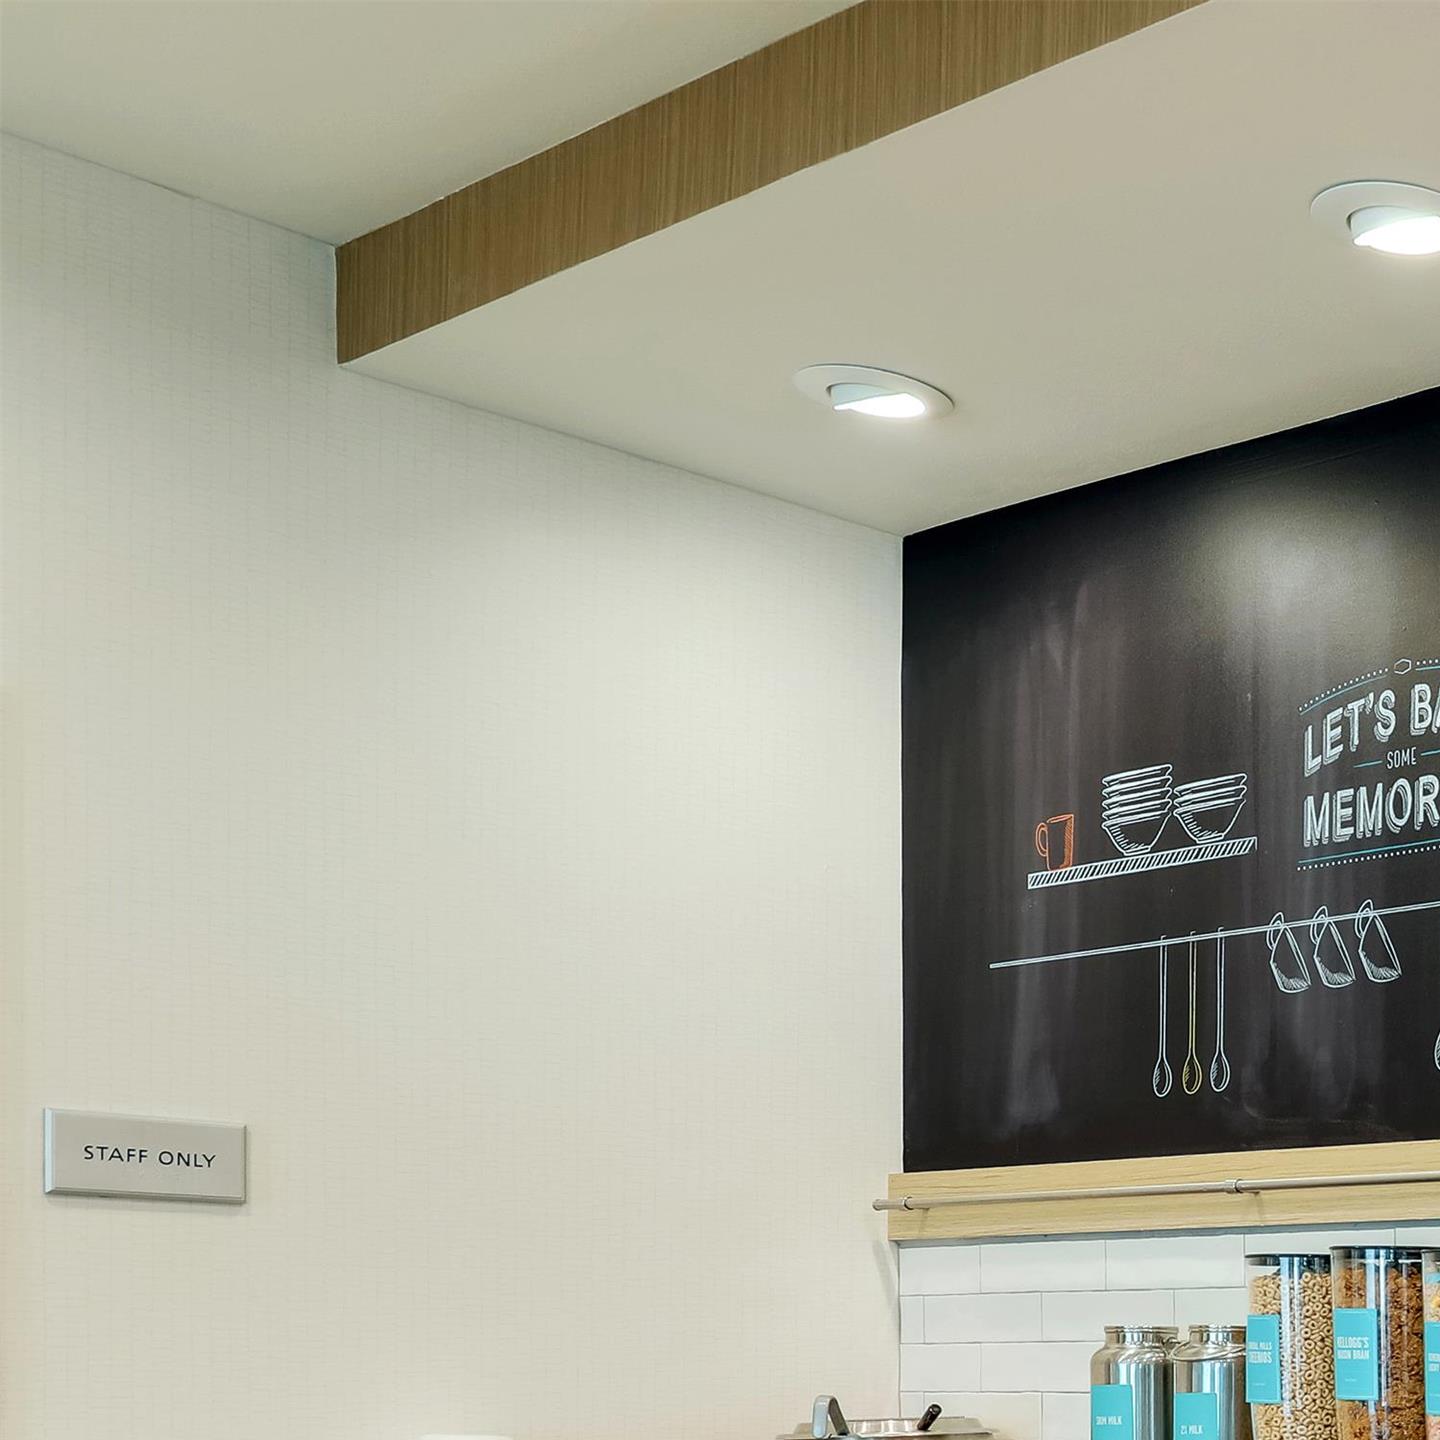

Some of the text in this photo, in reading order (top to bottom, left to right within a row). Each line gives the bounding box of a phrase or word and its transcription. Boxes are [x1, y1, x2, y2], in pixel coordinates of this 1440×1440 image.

[1304, 689, 1396, 777] LET'S
[1386, 747, 1417, 769] SOME
[84, 1145, 216, 1168] STAFF ONLY
